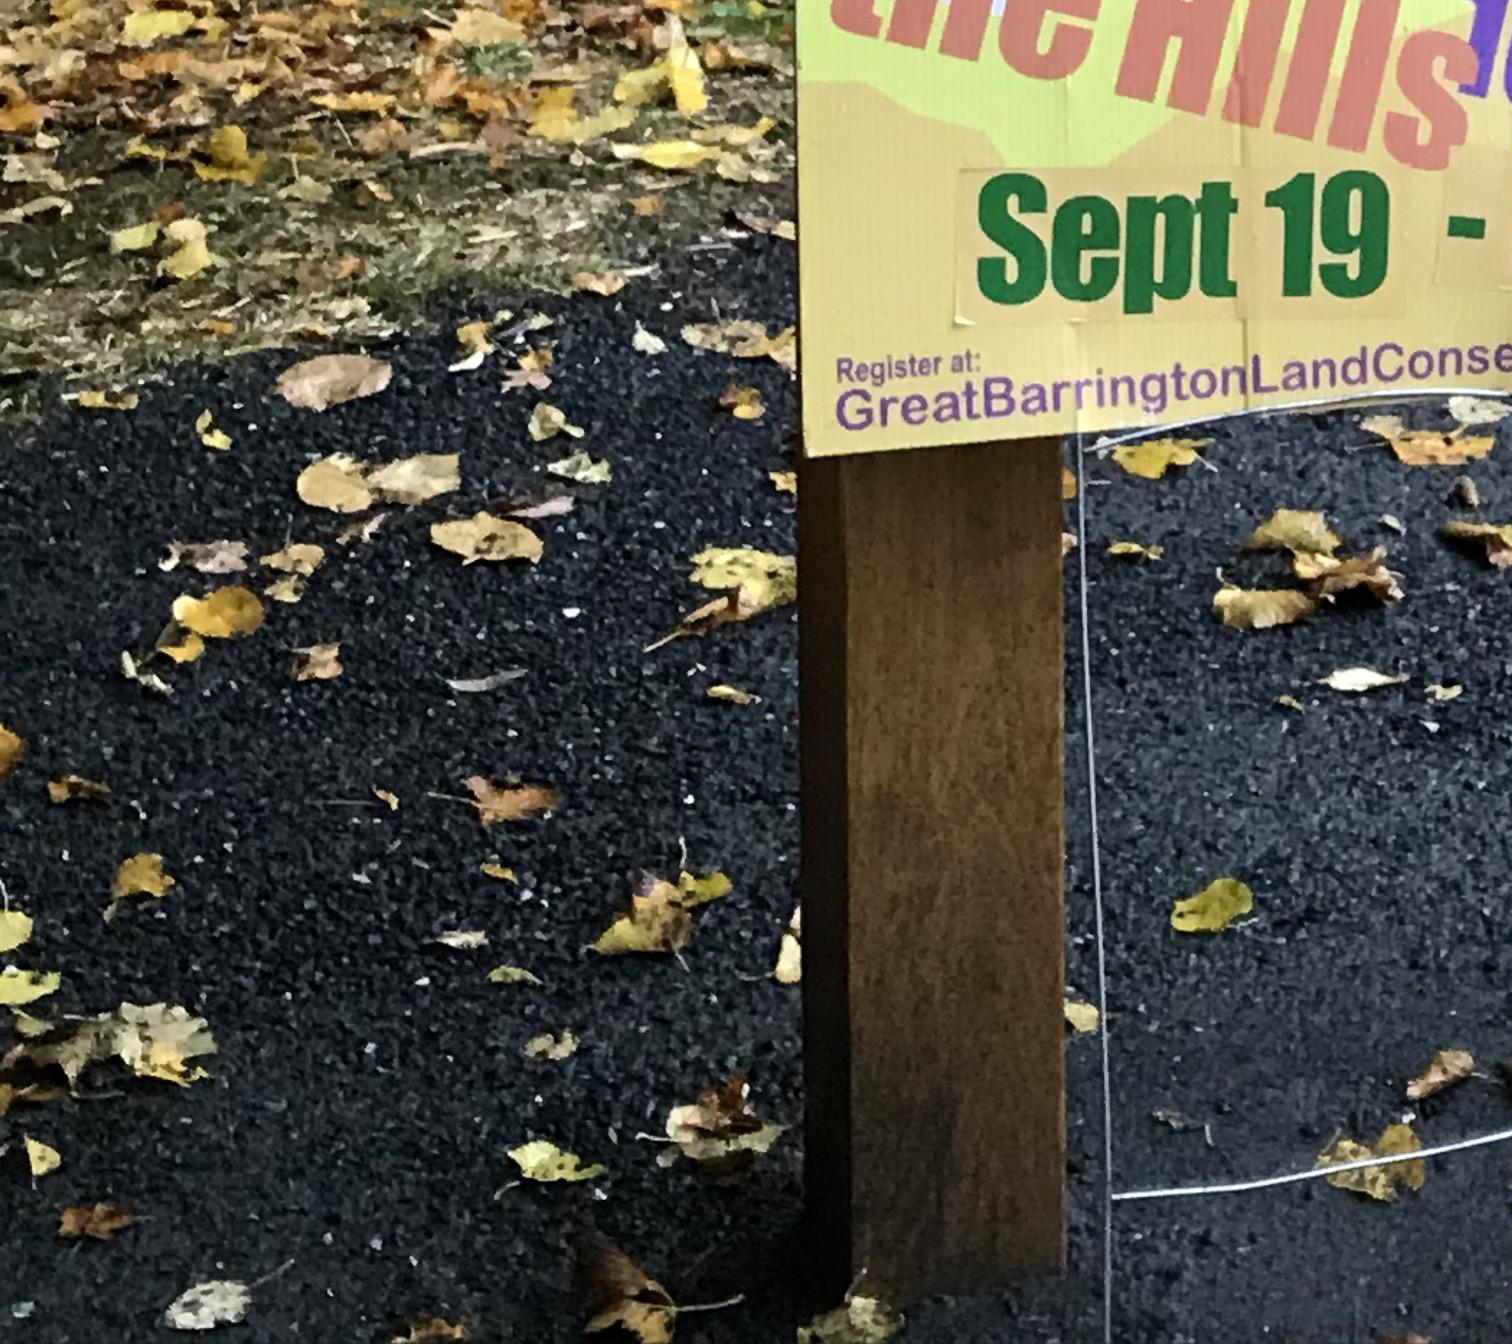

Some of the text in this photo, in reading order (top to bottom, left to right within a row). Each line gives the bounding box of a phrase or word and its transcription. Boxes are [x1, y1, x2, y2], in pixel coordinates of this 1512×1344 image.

[975, 171, 1239, 314] Sept
[1263, 169, 1392, 299] 19
[1446, 215, 1487, 240] -
[836, 348, 982, 388] Register at:
